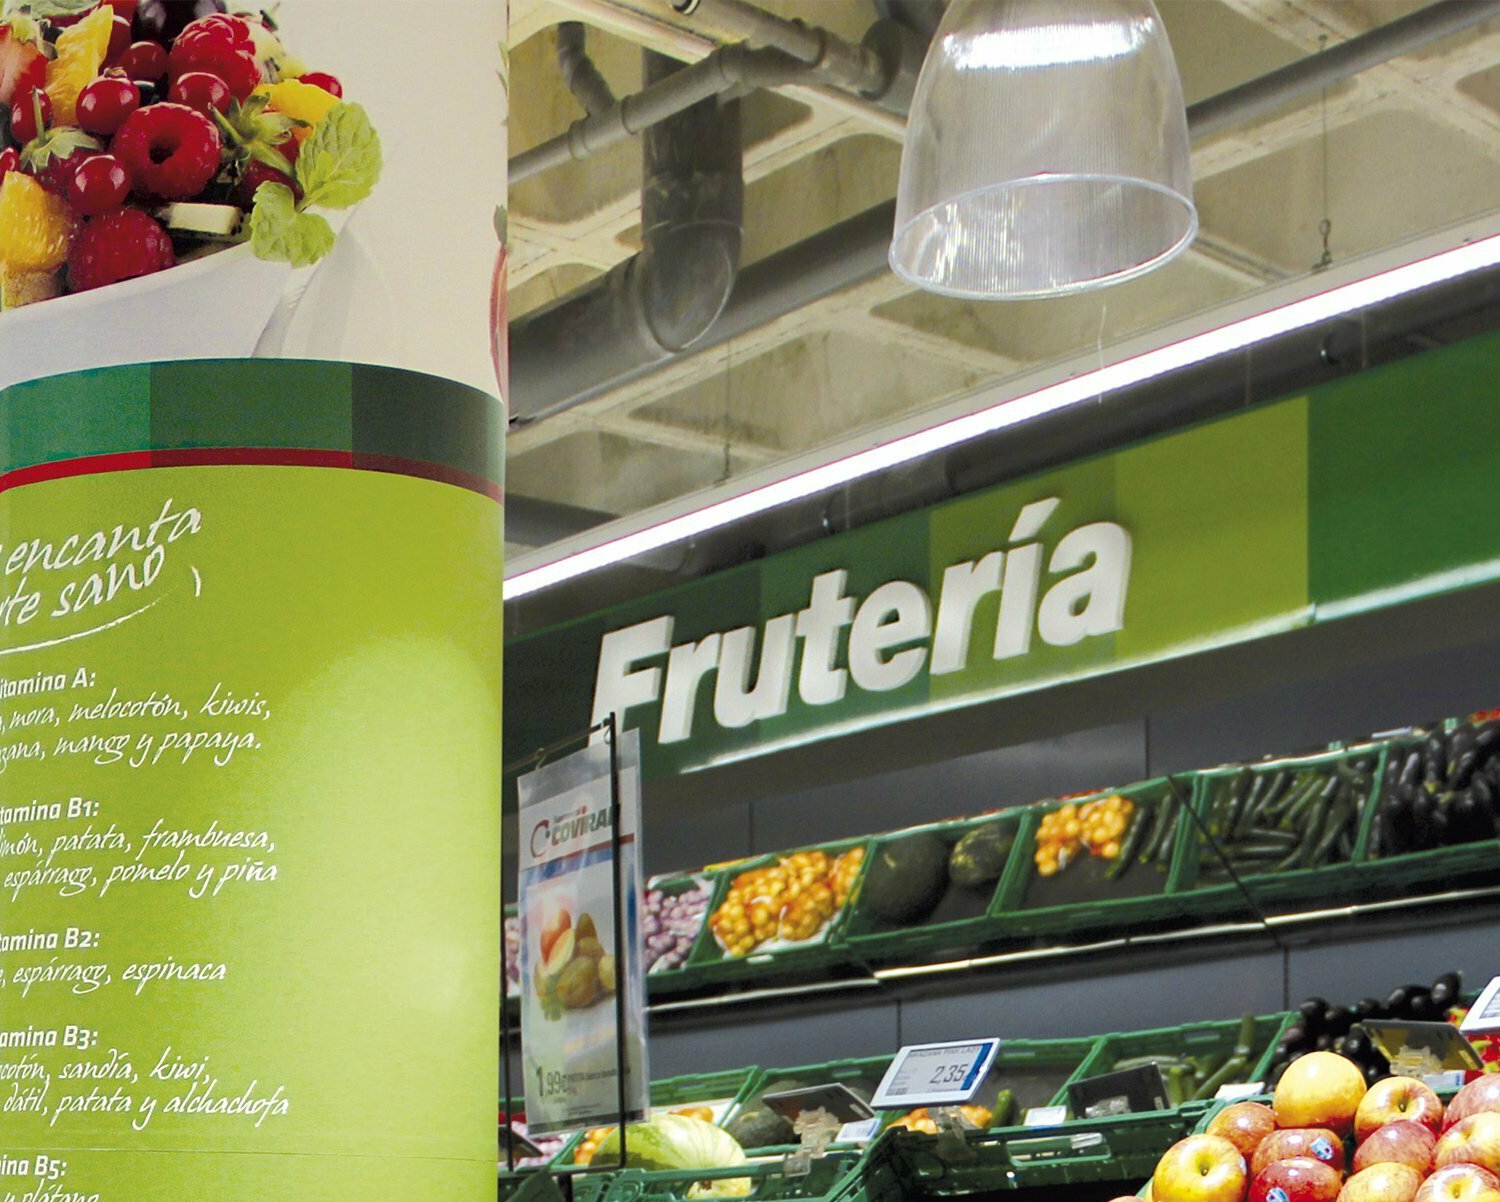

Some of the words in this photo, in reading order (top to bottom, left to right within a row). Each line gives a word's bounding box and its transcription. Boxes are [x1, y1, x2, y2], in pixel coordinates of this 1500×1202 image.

[6, 497, 202, 576] encanta
[51, 543, 165, 618] sano
[588, 497, 1133, 747] Frutería
[72, 667, 97, 689] A:
[9, 706, 61, 730] mora,
[68, 687, 189, 722] melocotón,
[200, 682, 271, 721] kiwis,
[53, 732, 131, 765] mango
[129, 732, 155, 768] y
[152, 731, 262, 767] papaya.
[67, 797, 101, 819] B1:
[46, 824, 132, 866] patata,
[136, 819, 276, 861] frambuesa,
[4, 860, 98, 903] espárrago,
[99, 850, 191, 899] pomelo
[188, 864, 213, 899] y
[213, 857, 278, 896] piña
[64, 927, 100, 949] B2:
[13, 957, 113, 998] espárrago,
[122, 956, 227, 997] espinaca
[63, 1025, 99, 1050] B3:
[59, 1048, 139, 1084] sandía,
[149, 1046, 211, 1084] kiwi,
[3, 1082, 50, 1116] dátil,
[50, 1087, 132, 1127] patata
[132, 1095, 157, 1131] y
[162, 1079, 290, 1128] alchachofa
[34, 1154, 68, 1180] B5:
